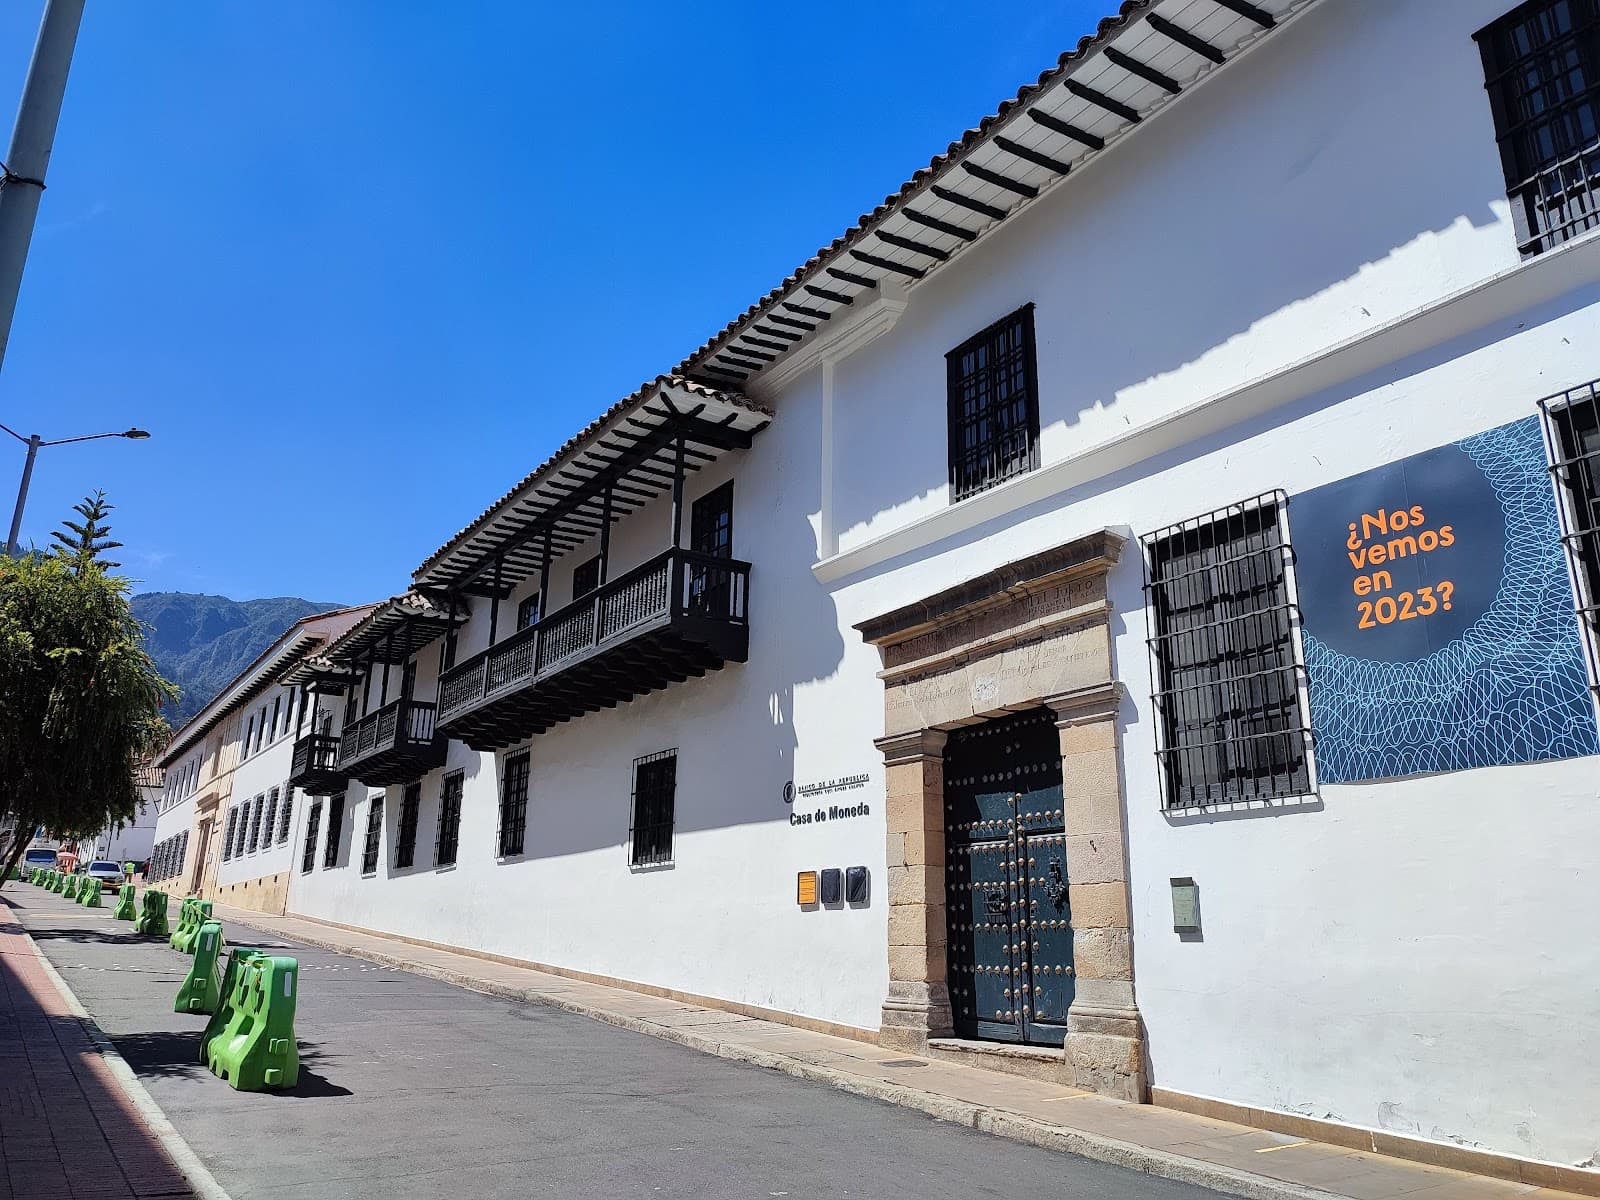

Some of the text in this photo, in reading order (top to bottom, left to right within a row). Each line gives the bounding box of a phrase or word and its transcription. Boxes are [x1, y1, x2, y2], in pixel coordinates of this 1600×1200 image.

[1346, 504, 1425, 551] ¿Nos
[1347, 525, 1455, 570] vemos
[1353, 570, 1393, 596] en
[1357, 580, 1455, 630] 2023?
[790, 801, 870, 826] Casa de Moneda
